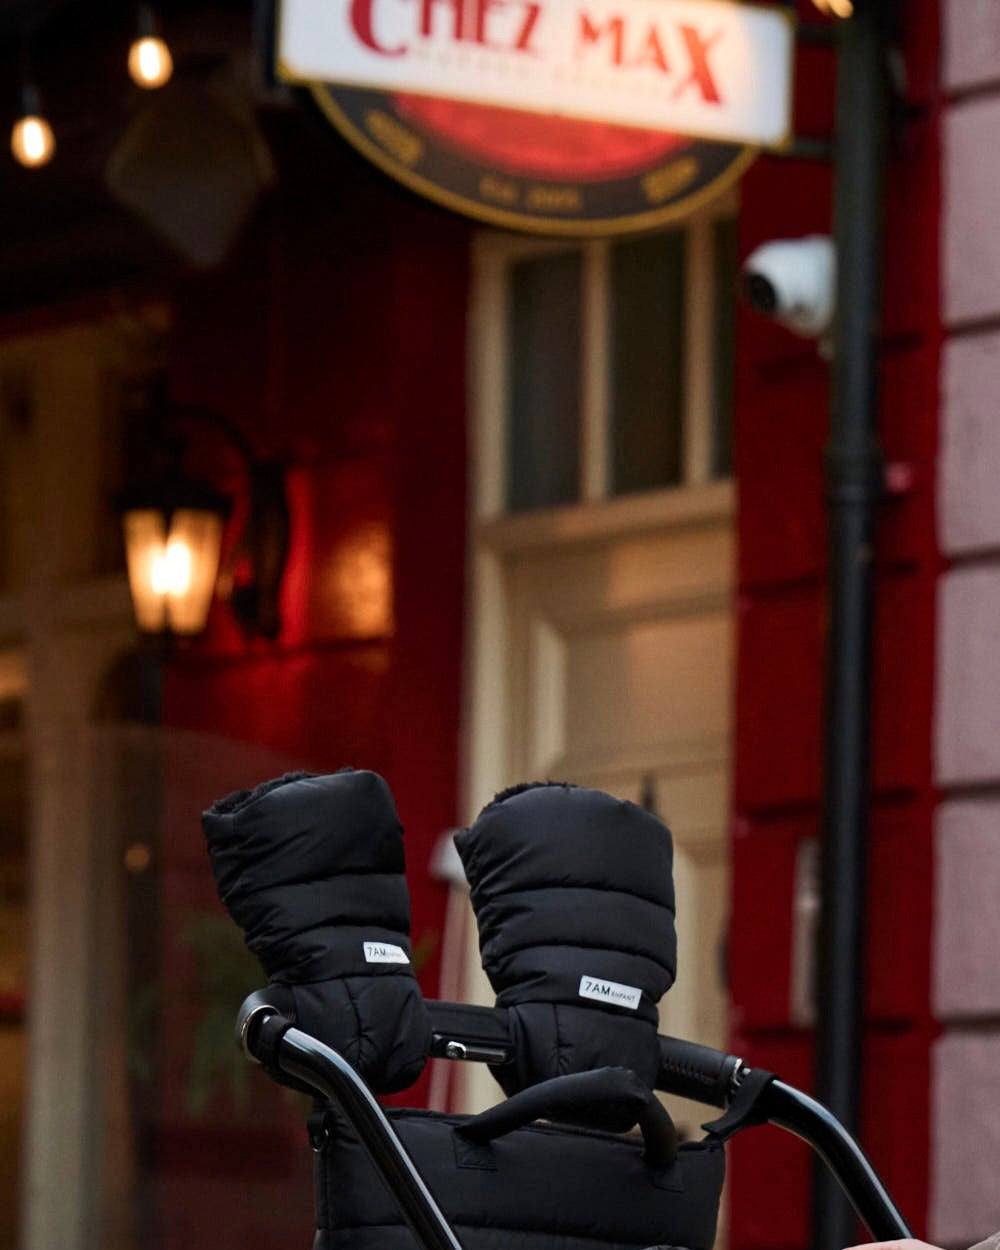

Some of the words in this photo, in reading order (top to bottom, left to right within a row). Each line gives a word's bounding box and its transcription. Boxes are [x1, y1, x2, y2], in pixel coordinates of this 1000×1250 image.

[348, 0, 540, 58] CHEZ
[576, 11, 724, 104] MAX
[585, 980, 610, 996] 7AM
